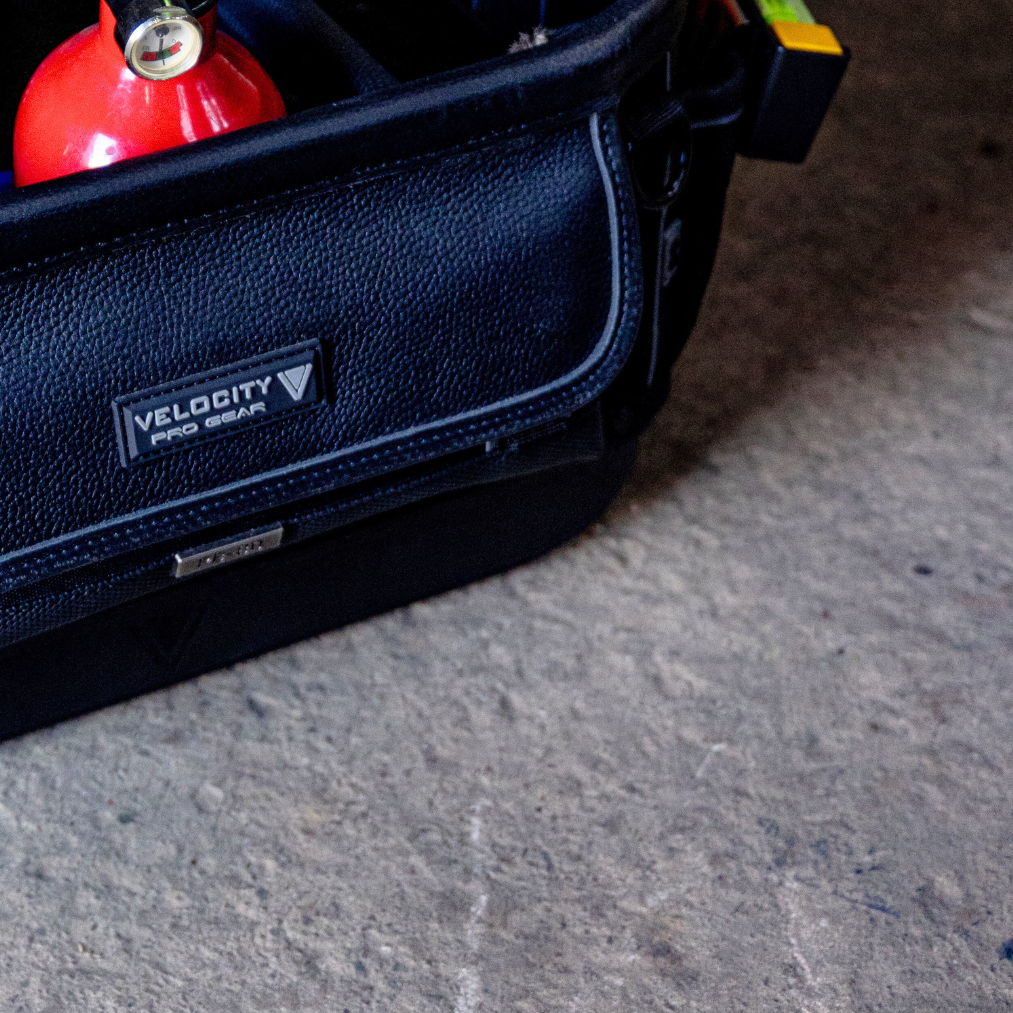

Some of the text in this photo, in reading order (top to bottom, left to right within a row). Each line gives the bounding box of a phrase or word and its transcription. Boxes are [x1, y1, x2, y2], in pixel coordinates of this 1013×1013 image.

[134, 375, 273, 432] VELOCITY
[151, 401, 267, 446] PRO GEAR
